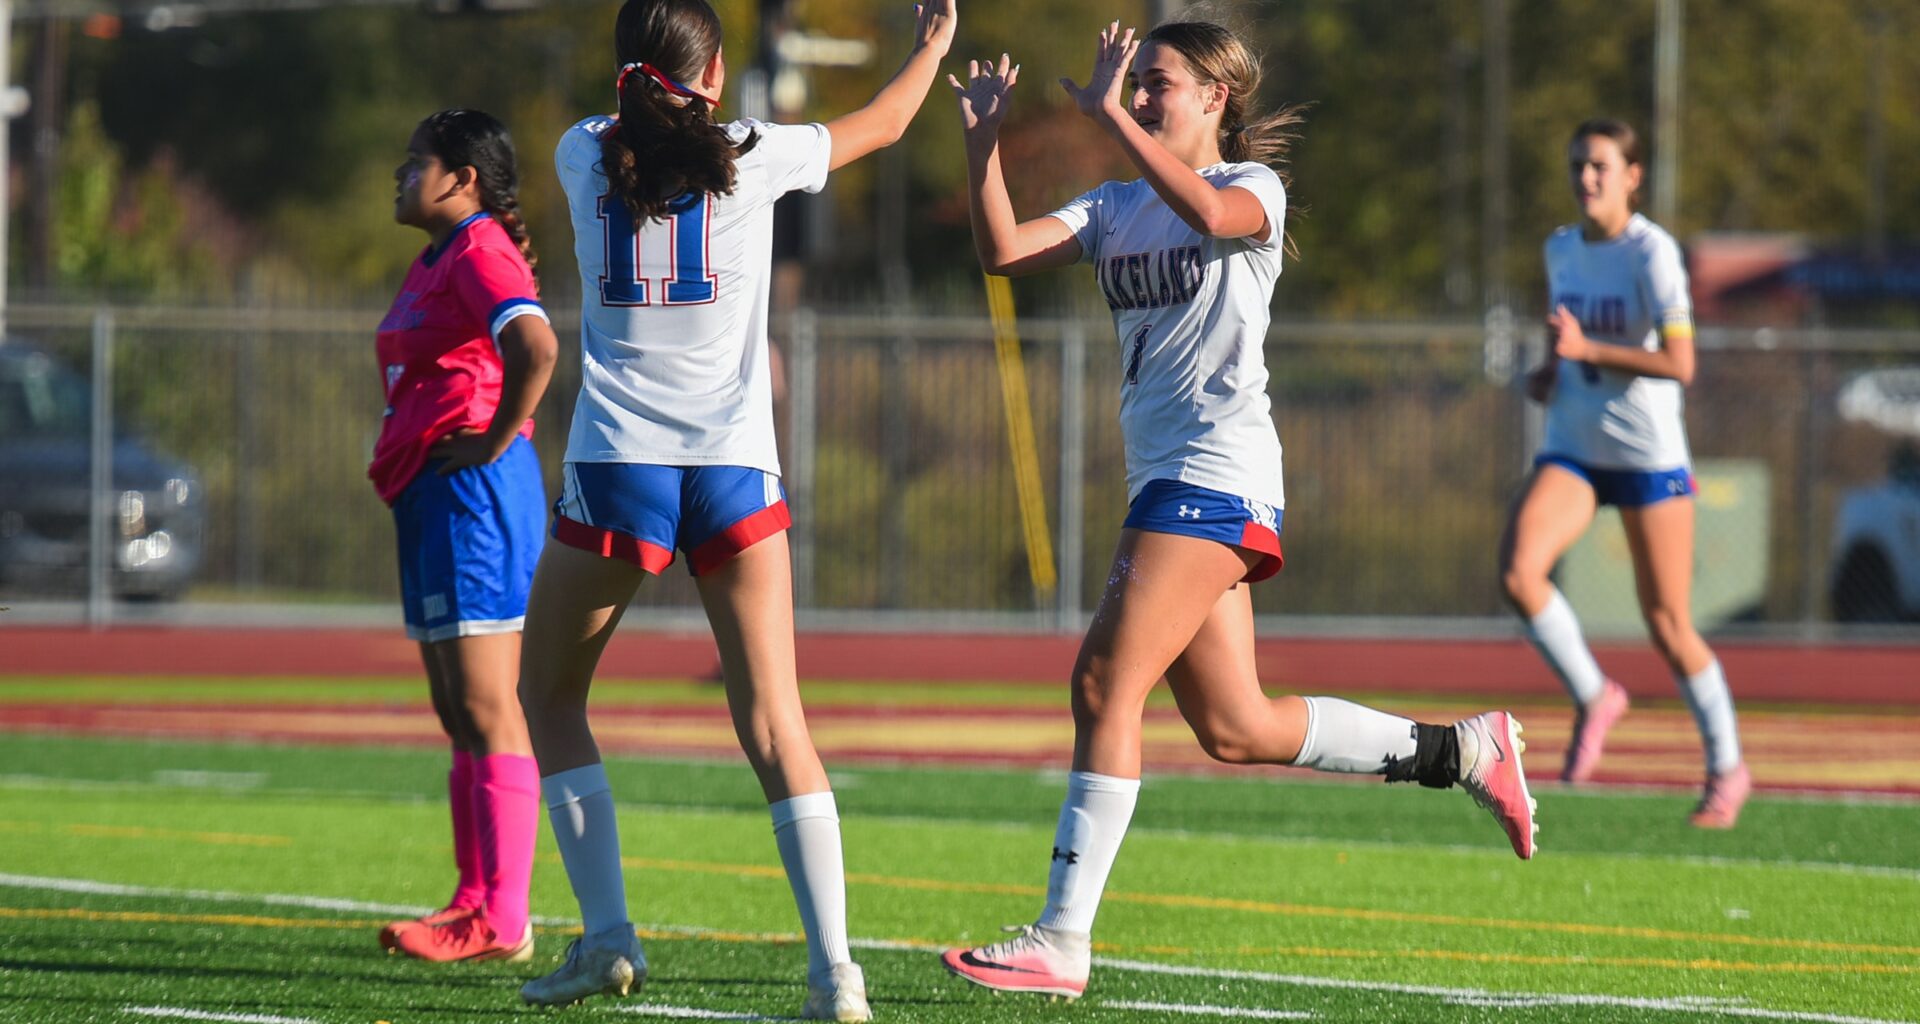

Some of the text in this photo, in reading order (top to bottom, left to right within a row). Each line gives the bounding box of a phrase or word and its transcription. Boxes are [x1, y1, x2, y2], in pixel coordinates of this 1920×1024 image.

[597, 187, 718, 307] 11
[1096, 246, 1205, 311] AKELAND
[1126, 324, 1152, 385] 1
